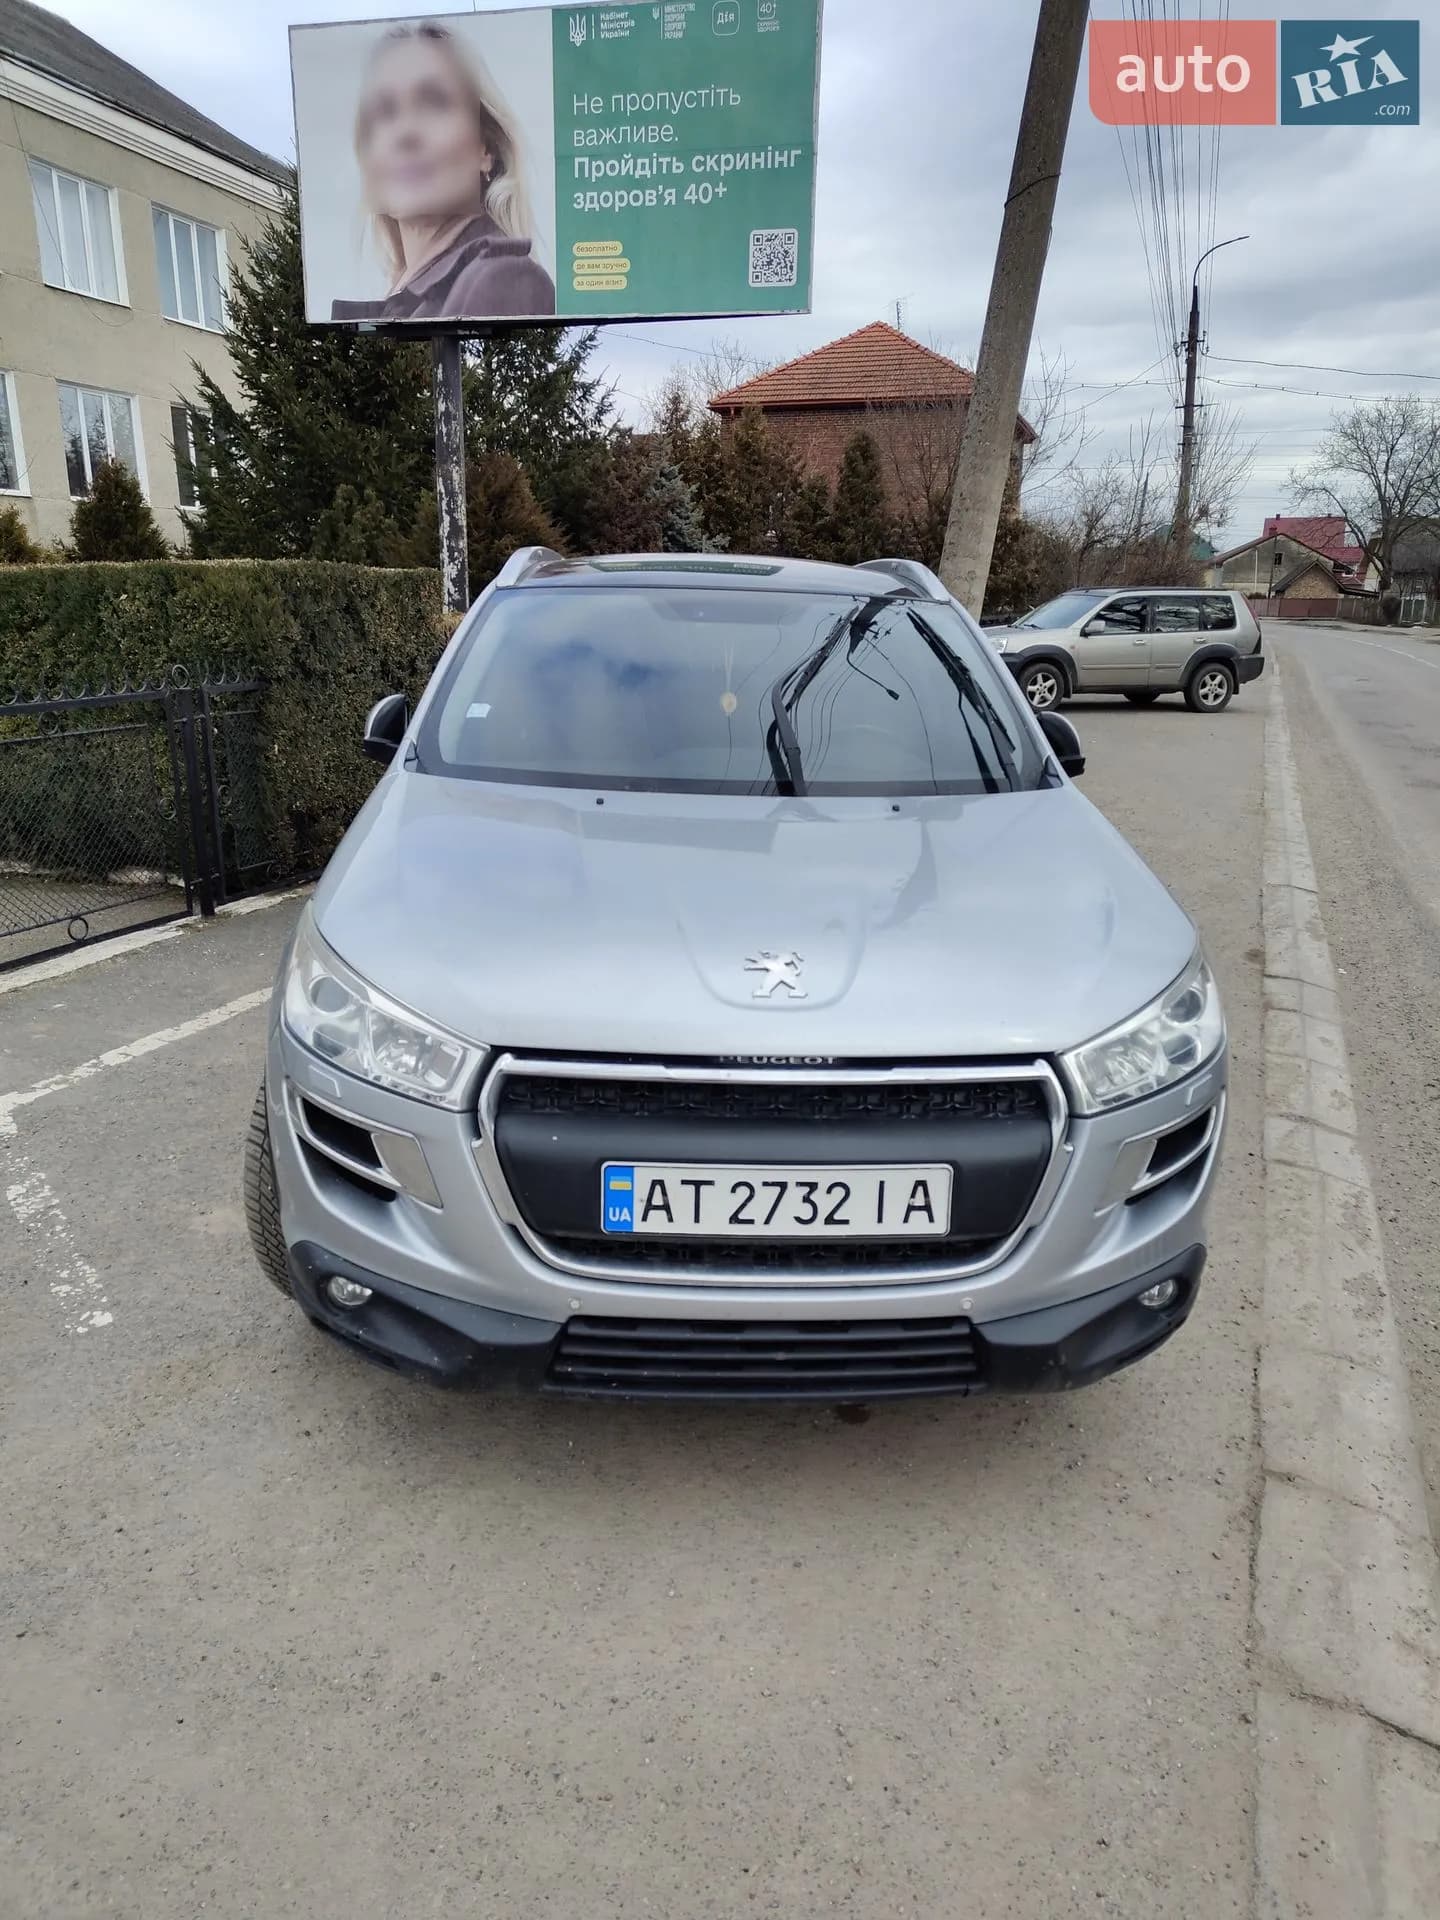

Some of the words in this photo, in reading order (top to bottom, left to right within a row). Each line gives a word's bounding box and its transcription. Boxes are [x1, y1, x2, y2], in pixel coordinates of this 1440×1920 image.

[600, 12, 629, 21] Кабінет
[600, 19, 635, 30] Міністрів
[717, 12, 735, 25] Дія
[600, 28, 630, 38] України
[573, 93, 604, 116] Не
[612, 84, 742, 117] пропустіть
[573, 124, 679, 147] важливе.
[574, 153, 685, 182] Пройдіть
[691, 146, 802, 176] скринінг
[573, 185, 676, 212] здоров’я
[684, 182, 728, 205] 40+
[641, 1179, 715, 1224] AT
[728, 1181, 850, 1225] 2732
[877, 1180, 935, 1224] IA
[608, 1207, 632, 1222] UA
